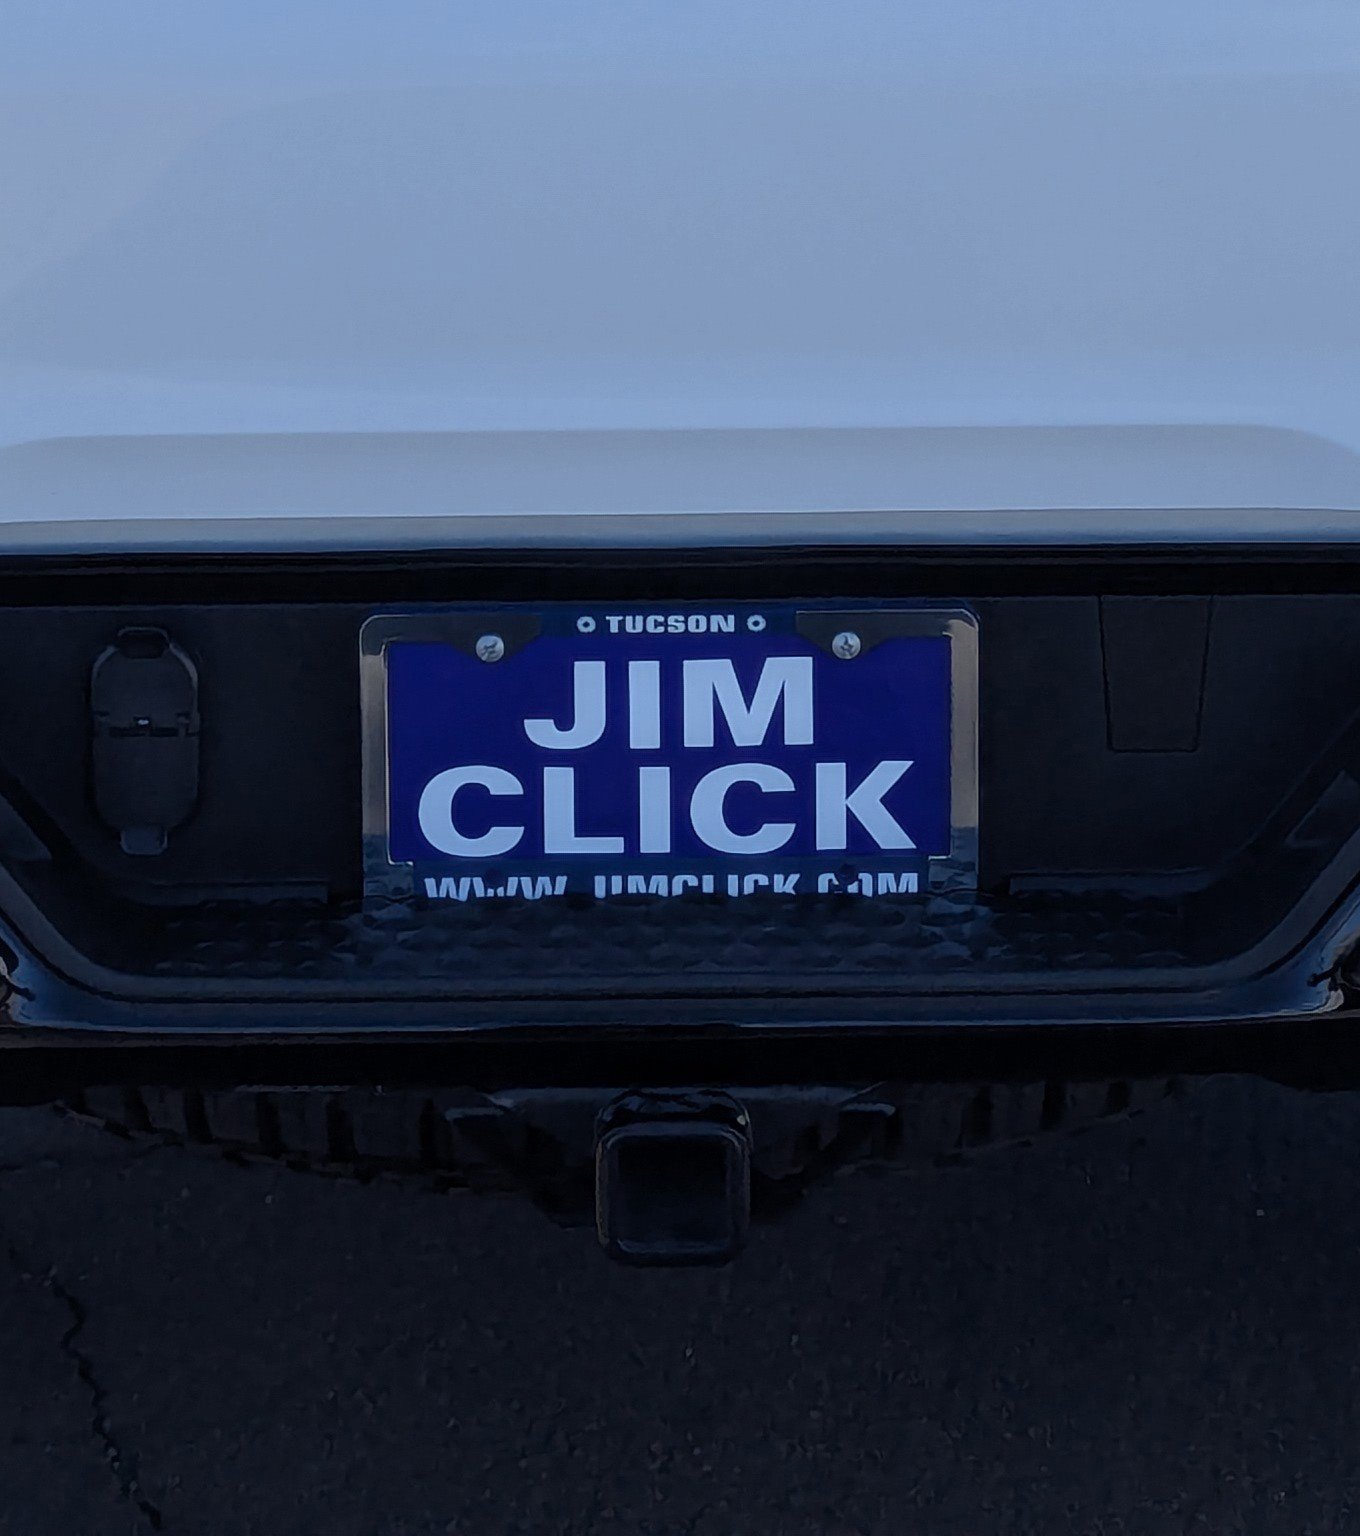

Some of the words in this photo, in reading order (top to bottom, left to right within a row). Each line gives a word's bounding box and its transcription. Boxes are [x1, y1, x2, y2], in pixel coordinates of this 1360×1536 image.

[605, 614, 736, 634] TUCSON
[522, 655, 815, 750] JIM
[417, 760, 917, 858] CLICK
[424, 871, 919, 901] WWWJIMCLICKCOM
